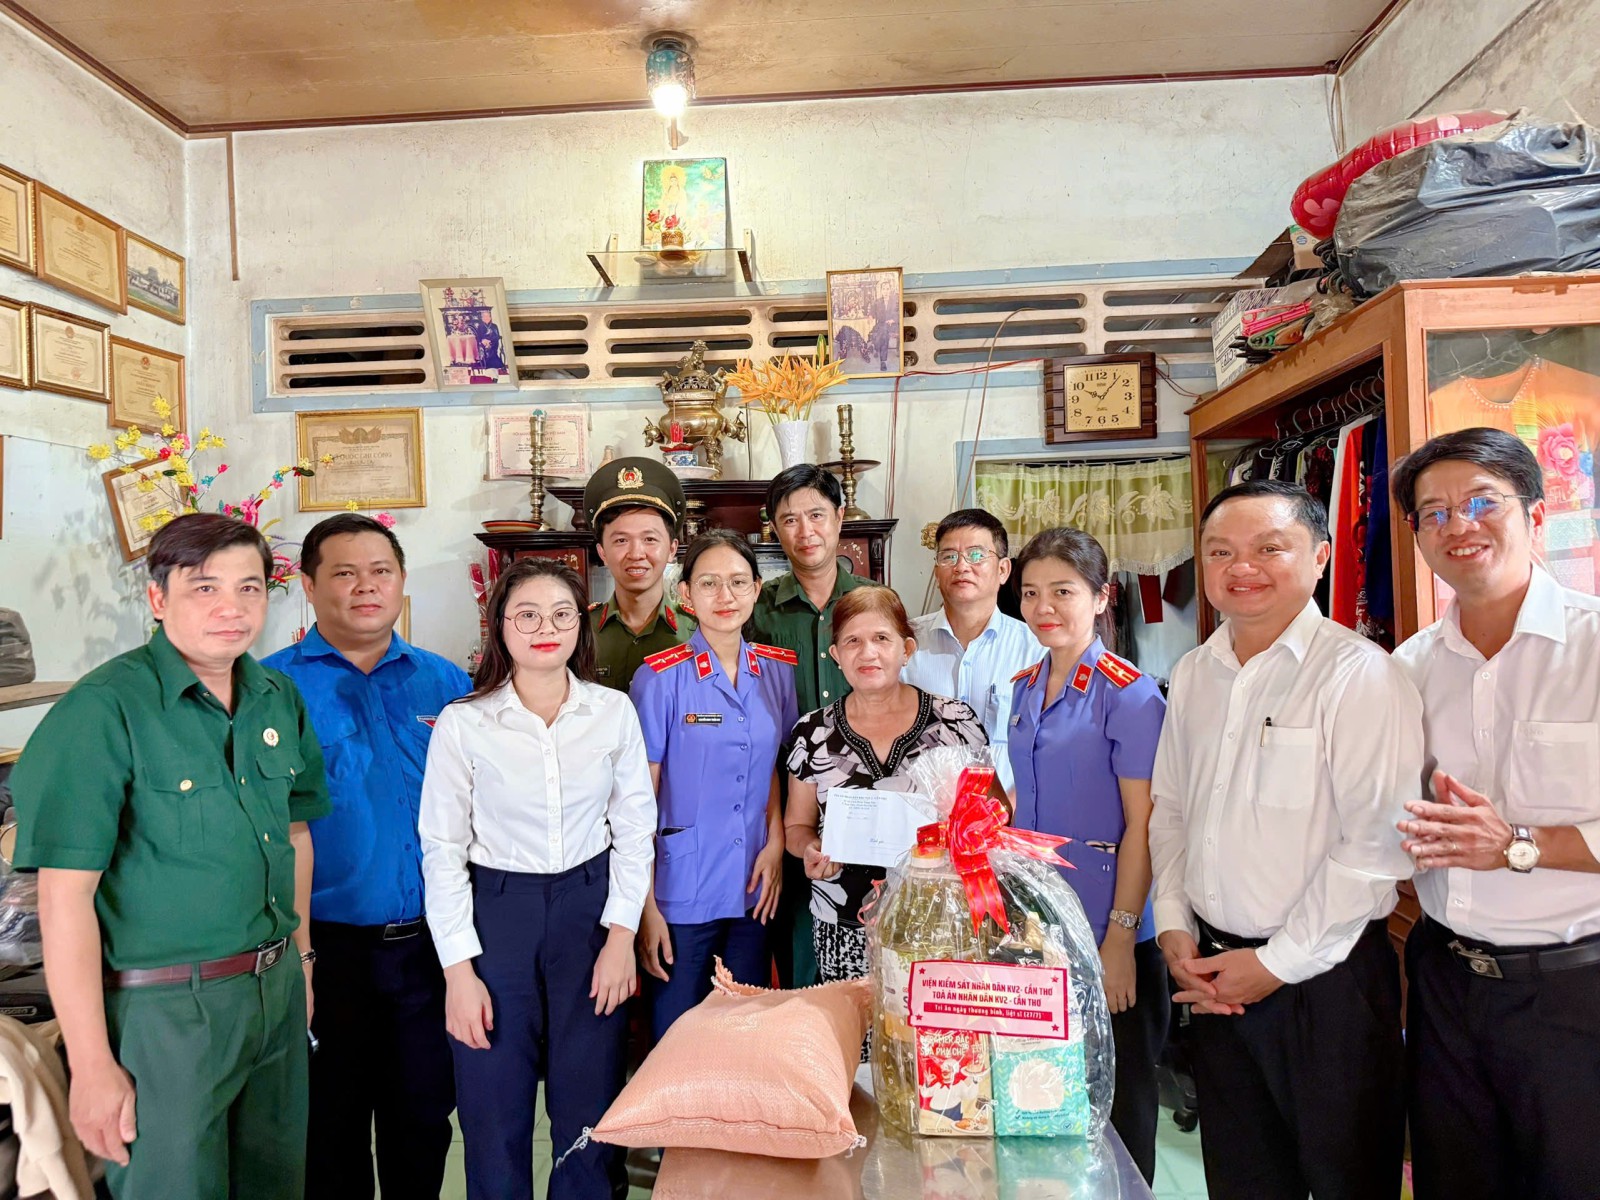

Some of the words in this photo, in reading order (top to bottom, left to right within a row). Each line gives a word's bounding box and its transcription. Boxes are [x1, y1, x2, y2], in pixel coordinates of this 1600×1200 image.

[1096, 372, 1107, 380] 12
[1073, 382, 1084, 390] 10
[1122, 378, 1130, 387] 2
[1071, 395, 1079, 404] 9
[1124, 392, 1132, 400] 3
[1074, 409, 1082, 417] 8
[1085, 416, 1092, 424] 7
[1098, 416, 1106, 424] 6
[1112, 415, 1119, 423] 5
[922, 977, 937, 988] VIỆN
[938, 976, 956, 988] KIỂM
[958, 979, 970, 989] SÁT
[972, 980, 990, 990] NHÂN
[992, 982, 1006, 992] DÂN
[1039, 986, 1053, 996] THƠ
[958, 992, 977, 1002] NHÂN
[979, 992, 994, 1003] DÂN
[995, 994, 1008, 1004] KV2
[1028, 998, 1041, 1007] THƠ
